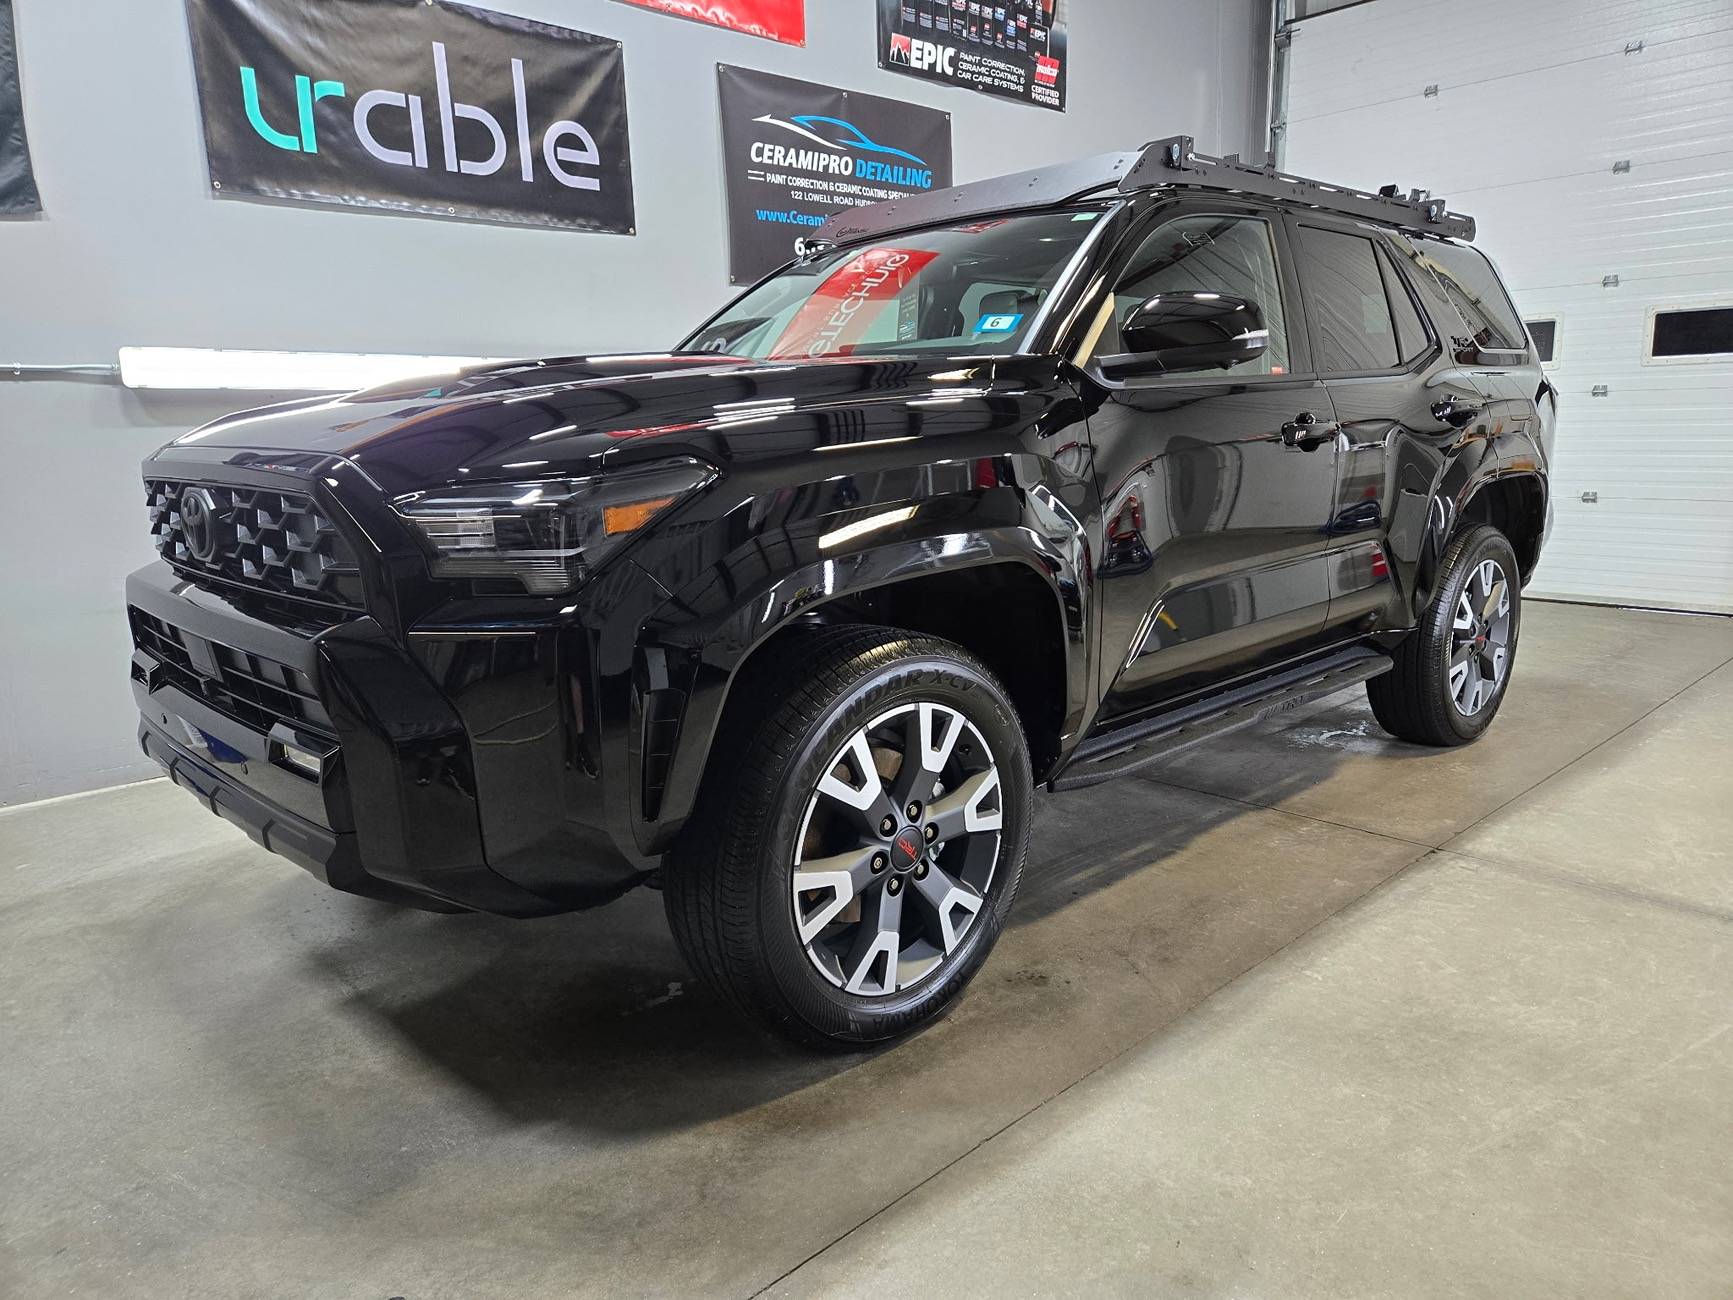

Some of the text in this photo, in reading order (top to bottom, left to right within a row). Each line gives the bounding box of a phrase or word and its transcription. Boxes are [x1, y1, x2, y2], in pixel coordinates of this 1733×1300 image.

[910, 38, 957, 76] EPIC
[959, 52, 1026, 76] PAINT CORRECTION,
[957, 70, 972, 80] CAR
[972, 74, 993, 85] CARE
[993, 78, 1024, 92] SYSTEMS
[958, 61, 990, 75] CERAMIC
[990, 69, 1019, 83] COATING,
[1031, 85, 1060, 98] CERTIFIED
[1031, 92, 1060, 106] PROVIDER
[239, 41, 600, 190] urable
[750, 142, 933, 189] CERAMIPRO DETAILING
[766, 173, 787, 186] PAINT
[787, 176, 829, 191] CORRECTION
[834, 182, 863, 196] CERAMIC
[862, 186, 888, 199] COATING
[790, 190, 803, 200] 122
[803, 191, 833, 204] LOWELL
[833, 195, 854, 206] ROAD
